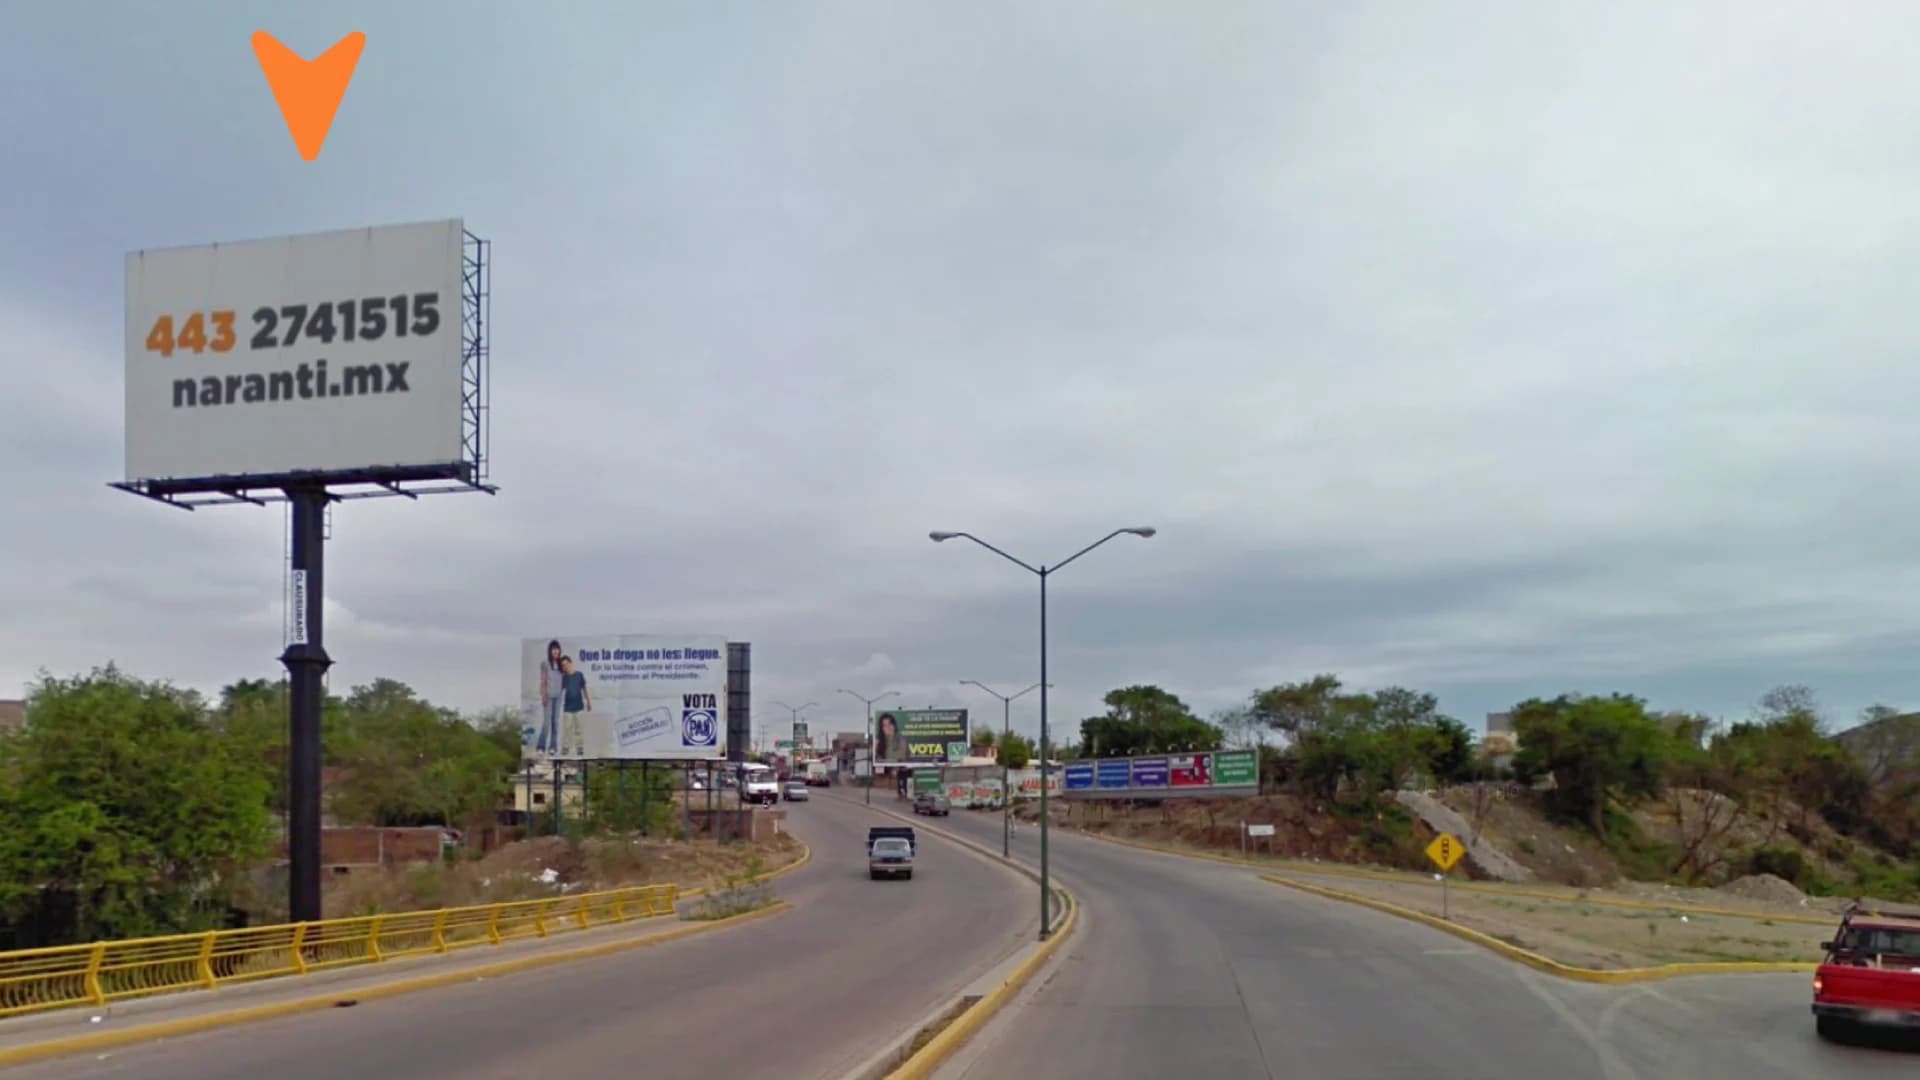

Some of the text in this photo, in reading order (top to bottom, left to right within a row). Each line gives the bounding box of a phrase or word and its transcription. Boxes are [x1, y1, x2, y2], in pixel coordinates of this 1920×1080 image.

[146, 292, 440, 357] 443 2741515
[172, 360, 411, 408] naranti.mx
[295, 571, 304, 641] CLAUSURADO
[580, 649, 600, 662] Que
[601, 648, 611, 660] la
[613, 649, 645, 661] droga
[647, 649, 661, 660] no
[683, 693, 717, 708] VOTA
[689, 719, 711, 737] PAN
[908, 743, 945, 755] VOTA
